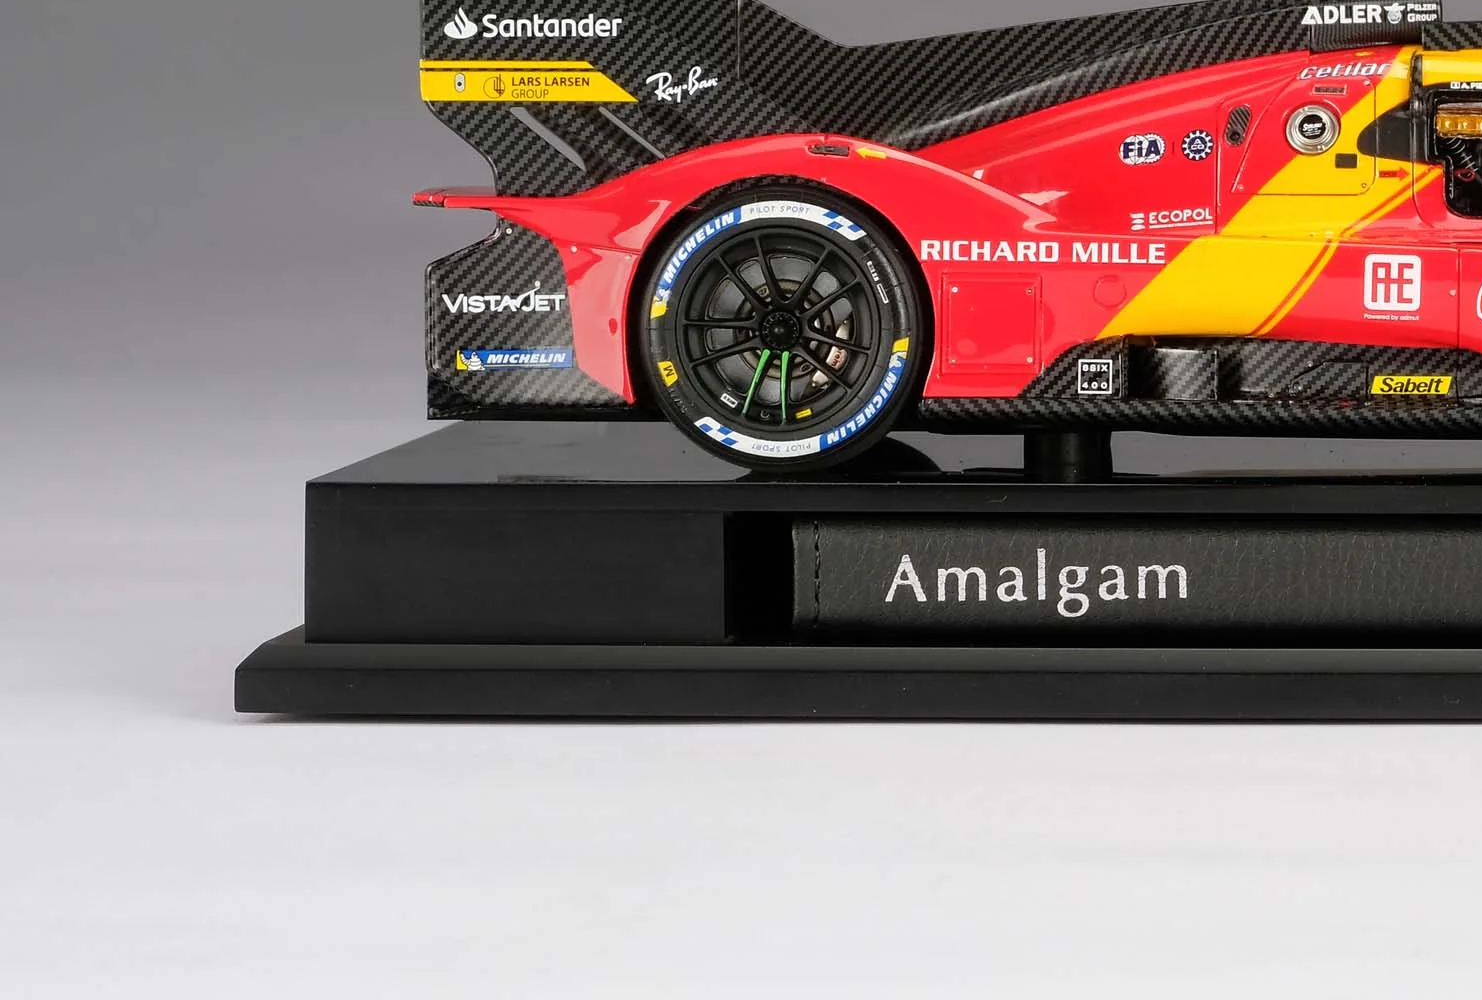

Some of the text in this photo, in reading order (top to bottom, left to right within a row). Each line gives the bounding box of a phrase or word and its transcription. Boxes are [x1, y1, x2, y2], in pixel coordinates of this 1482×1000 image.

[1301, 4, 1382, 25] ADLER
[1407, 13, 1438, 23] GROUP
[482, 13, 623, 38] Santander
[511, 77, 590, 87] LARS LARSEN
[511, 89, 550, 99] GROUP
[779, 205, 811, 216] SPORT
[1149, 207, 1213, 224] ECOPOL
[662, 210, 735, 284] MICHELIN
[920, 239, 1167, 265] RICHARD MILLE
[486, 353, 567, 364] MICHELIN
[1379, 376, 1443, 394] Sabelt
[827, 371, 898, 445] MICHELIN
[885, 547, 1189, 618] Amalgam
